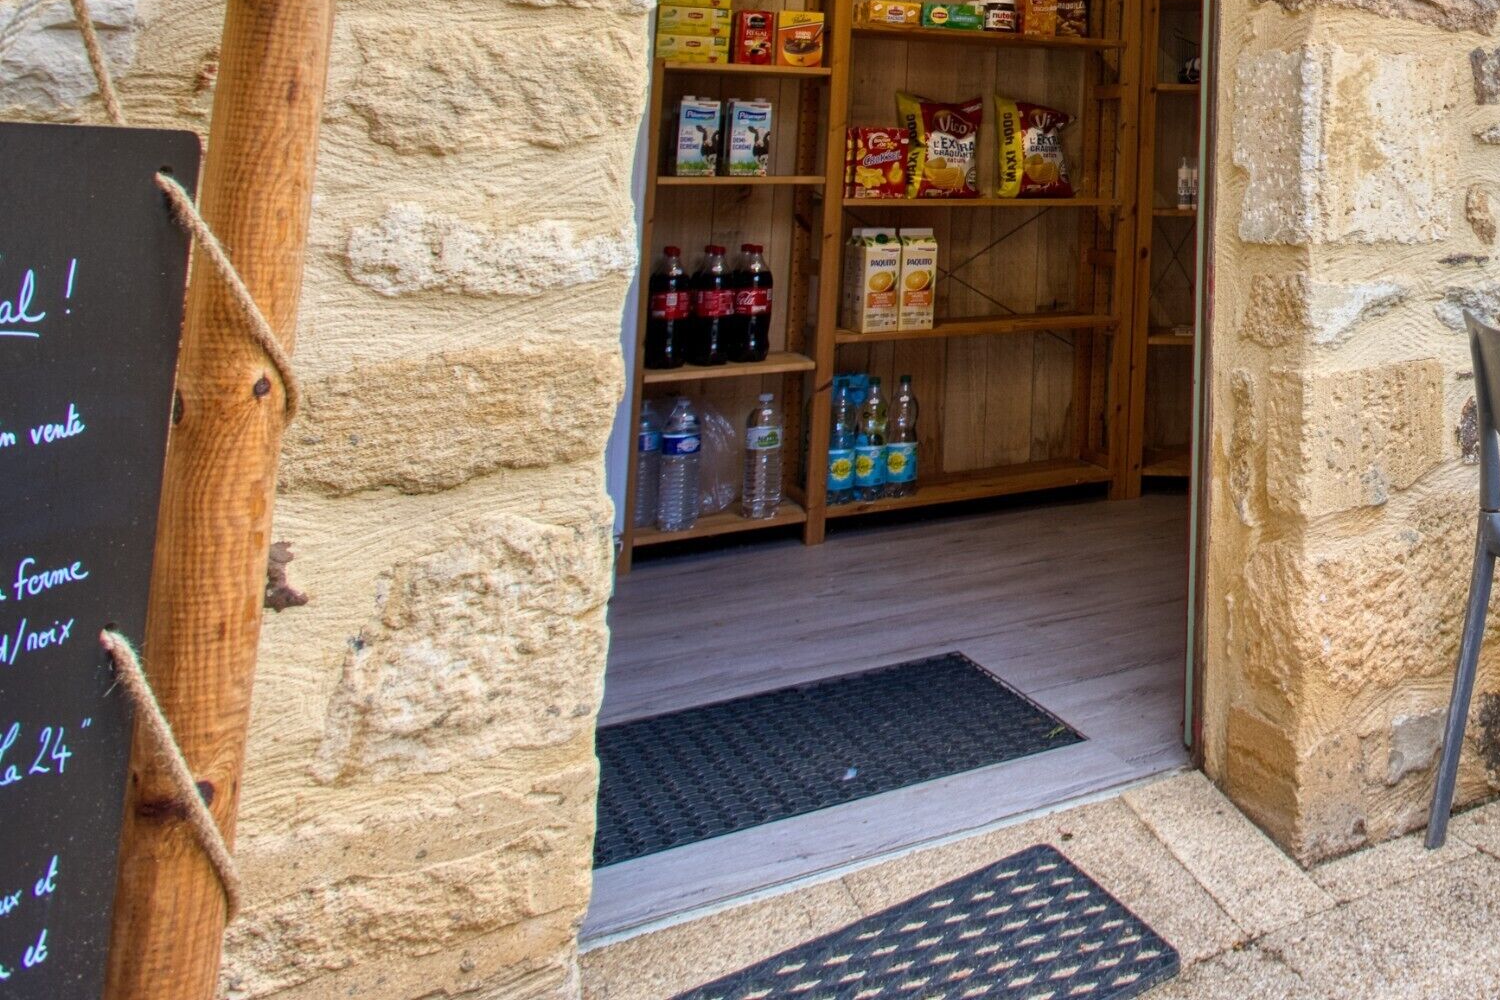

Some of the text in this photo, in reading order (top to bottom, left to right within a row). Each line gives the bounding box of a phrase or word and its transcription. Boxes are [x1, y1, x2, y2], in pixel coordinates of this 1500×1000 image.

[939, 114, 968, 134] Vico
[1005, 150, 1016, 182] MAXI
[31, 402, 85, 444] vente
